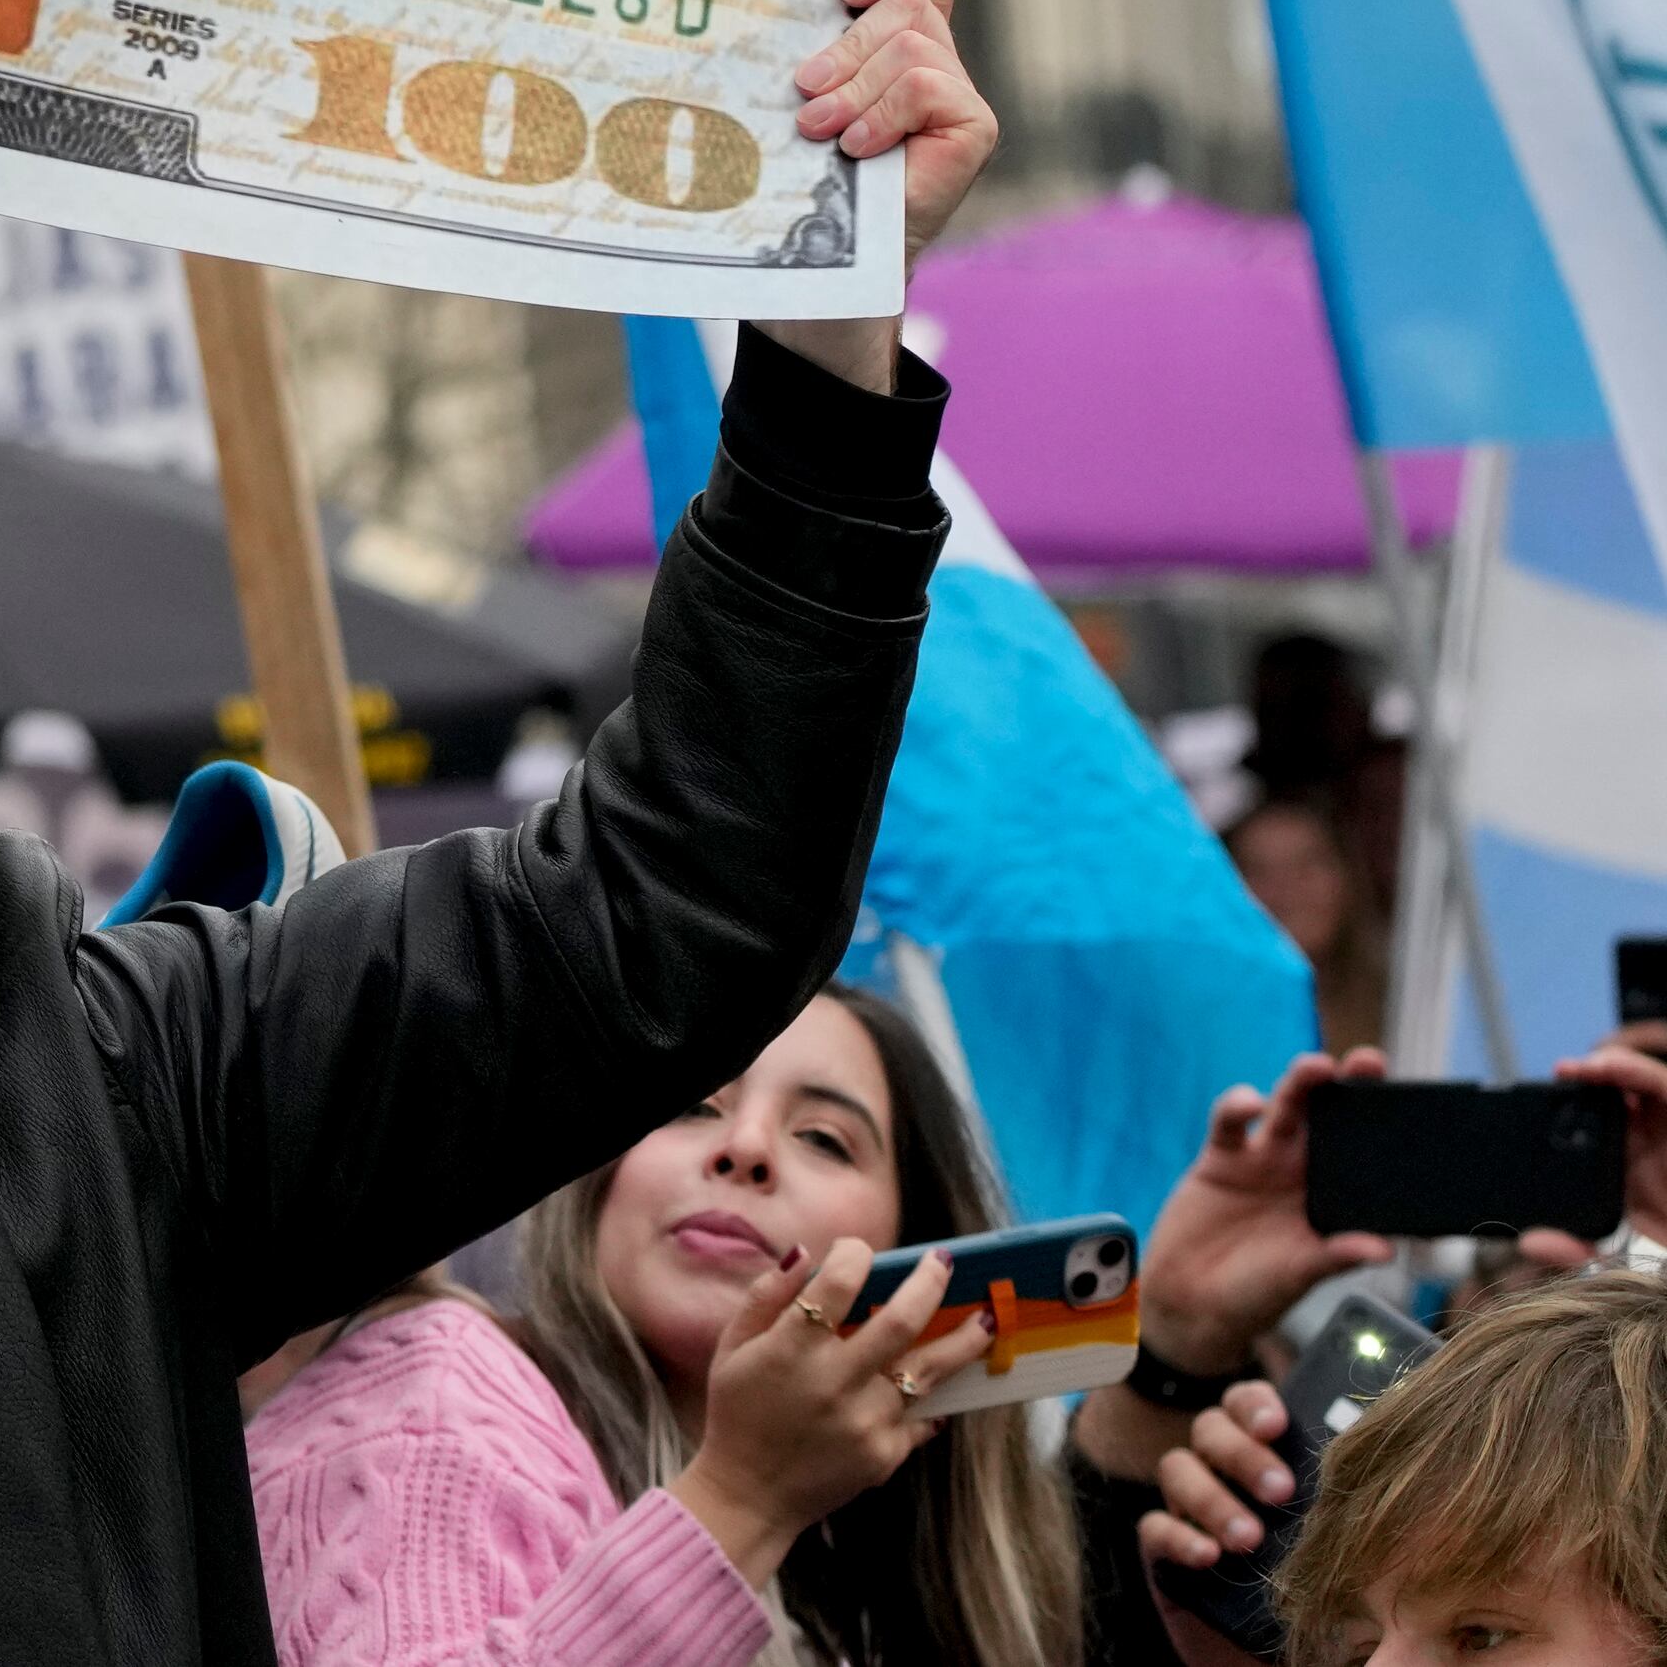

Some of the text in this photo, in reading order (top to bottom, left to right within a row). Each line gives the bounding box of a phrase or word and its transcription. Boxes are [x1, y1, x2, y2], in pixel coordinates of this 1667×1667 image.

[122, 26, 201, 63] 2009
[146, 57, 168, 82] A
[279, 34, 762, 214] 100
